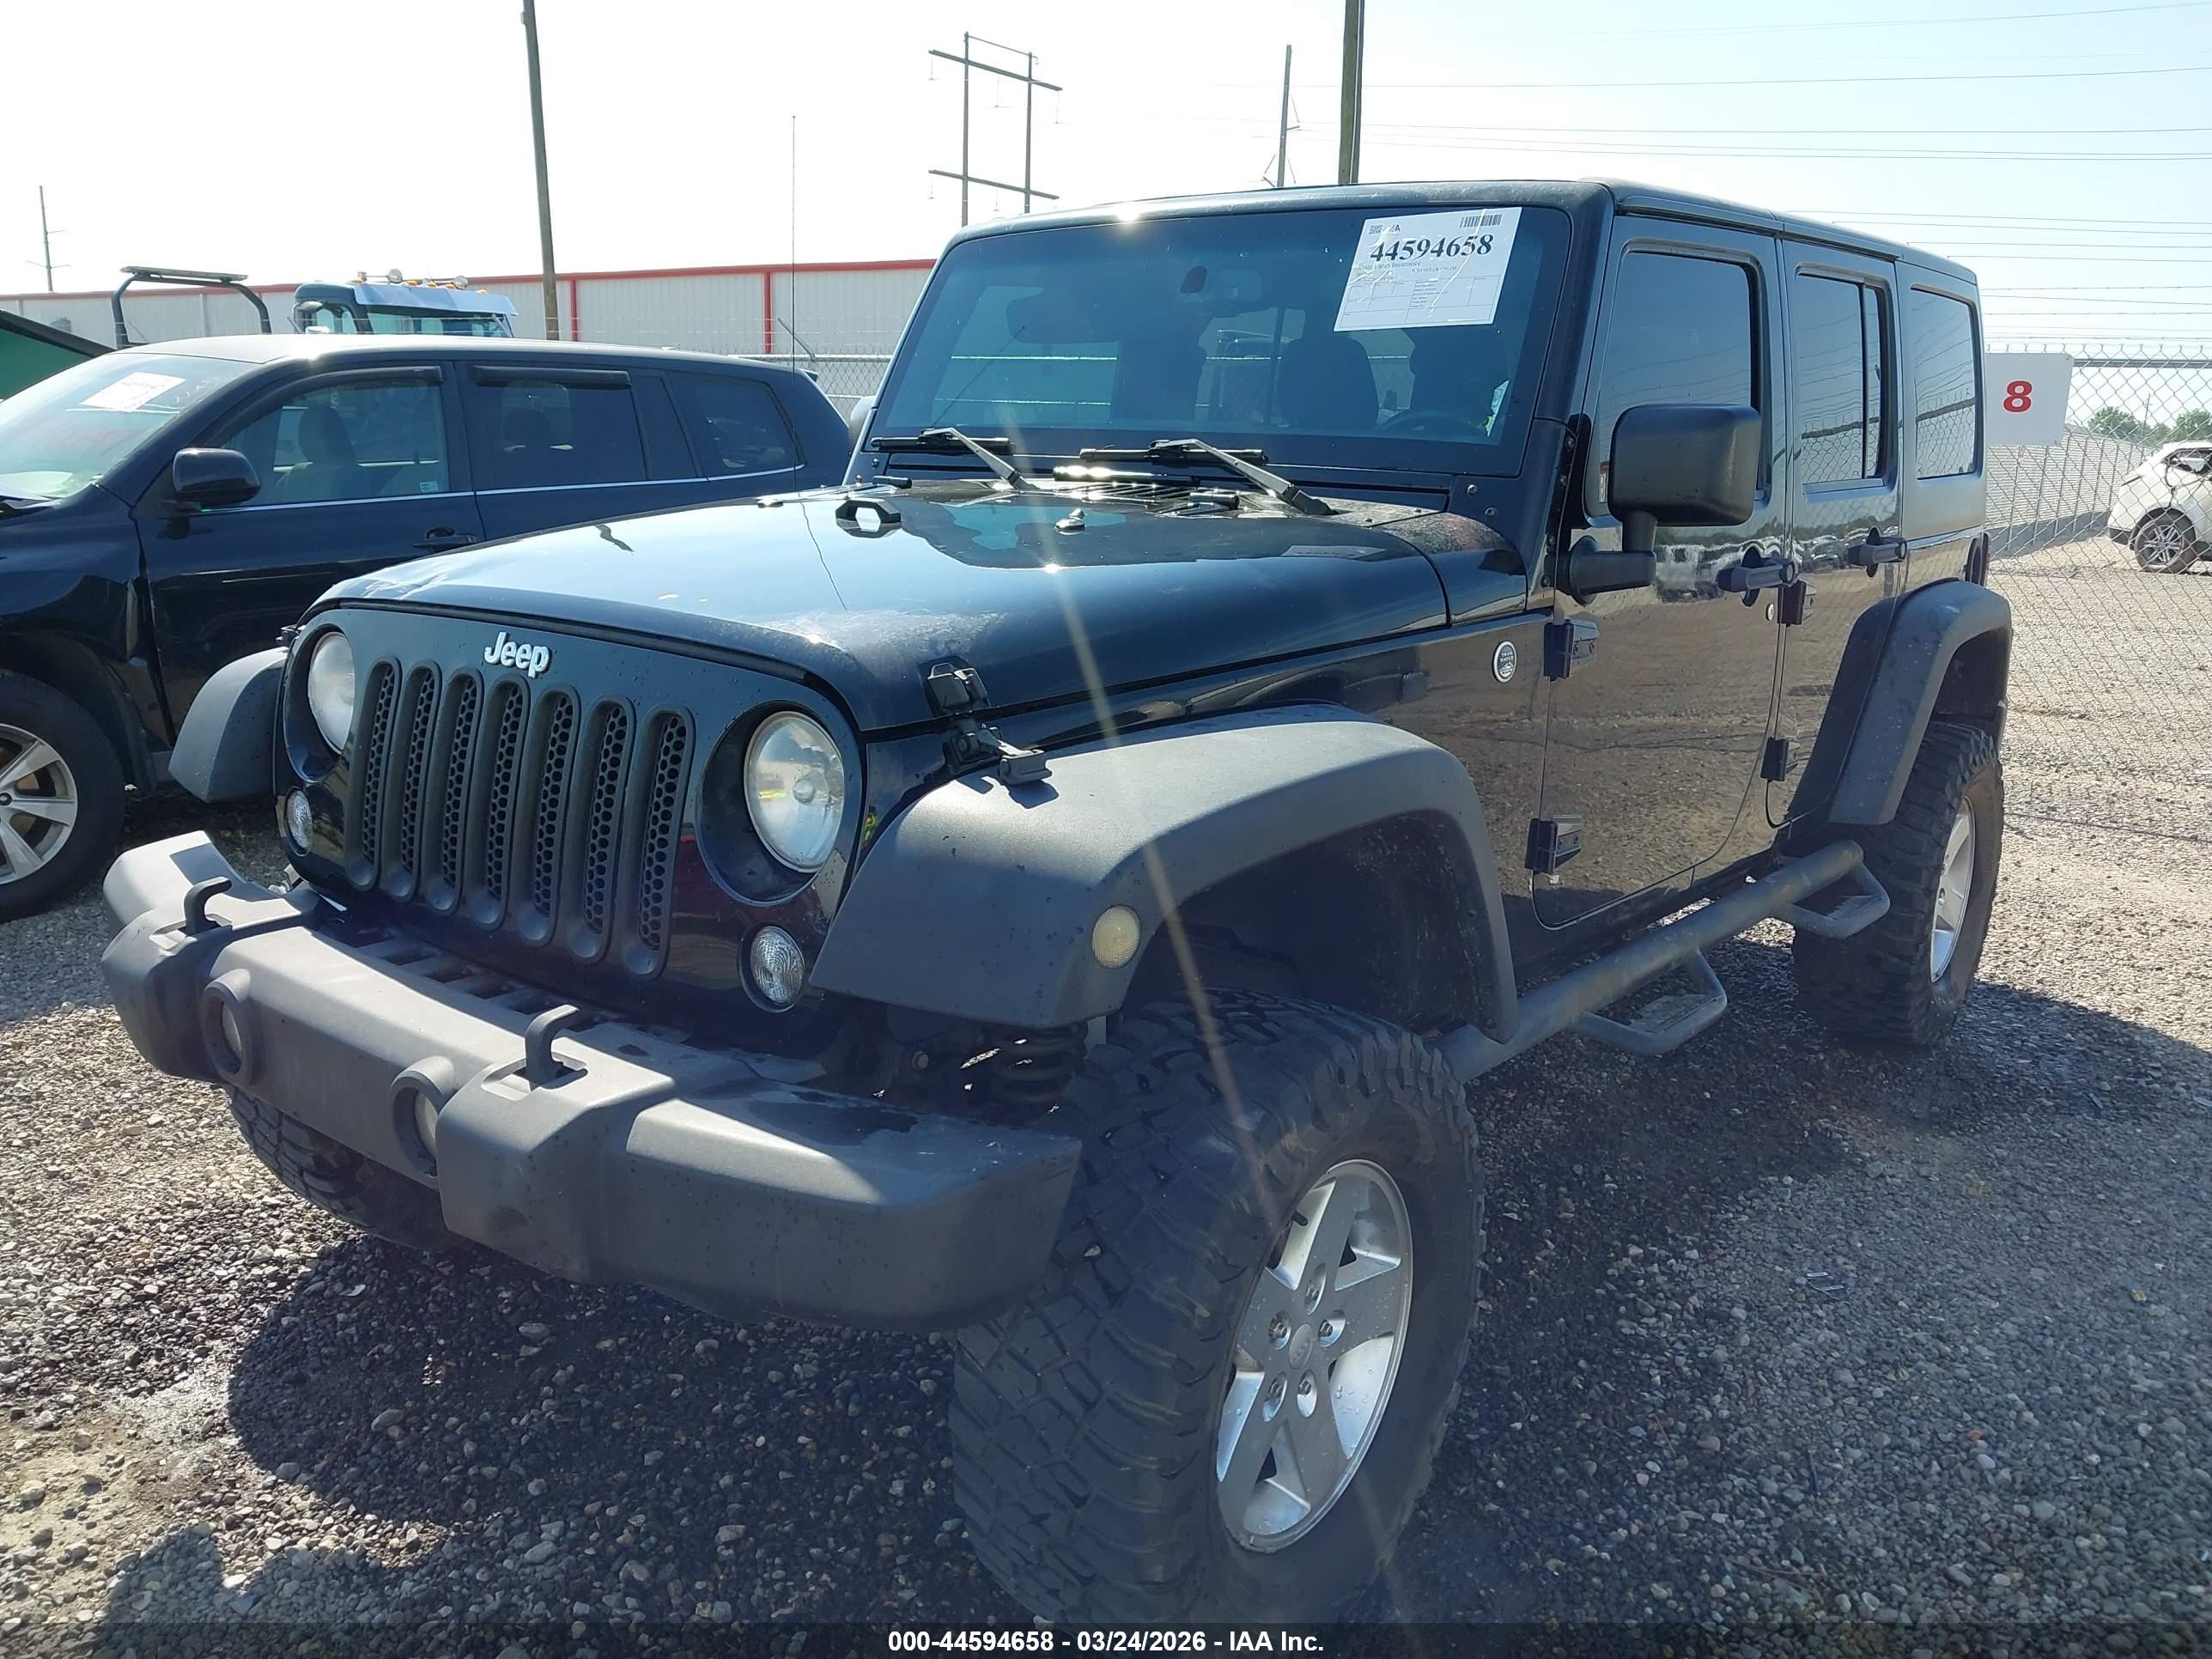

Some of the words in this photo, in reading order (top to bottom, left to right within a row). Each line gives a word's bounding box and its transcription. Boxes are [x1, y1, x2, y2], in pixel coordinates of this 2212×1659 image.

[1370, 234, 1494, 262] 44594658
[2002, 380, 2033, 413] 8
[483, 631, 550, 679] Jeep
